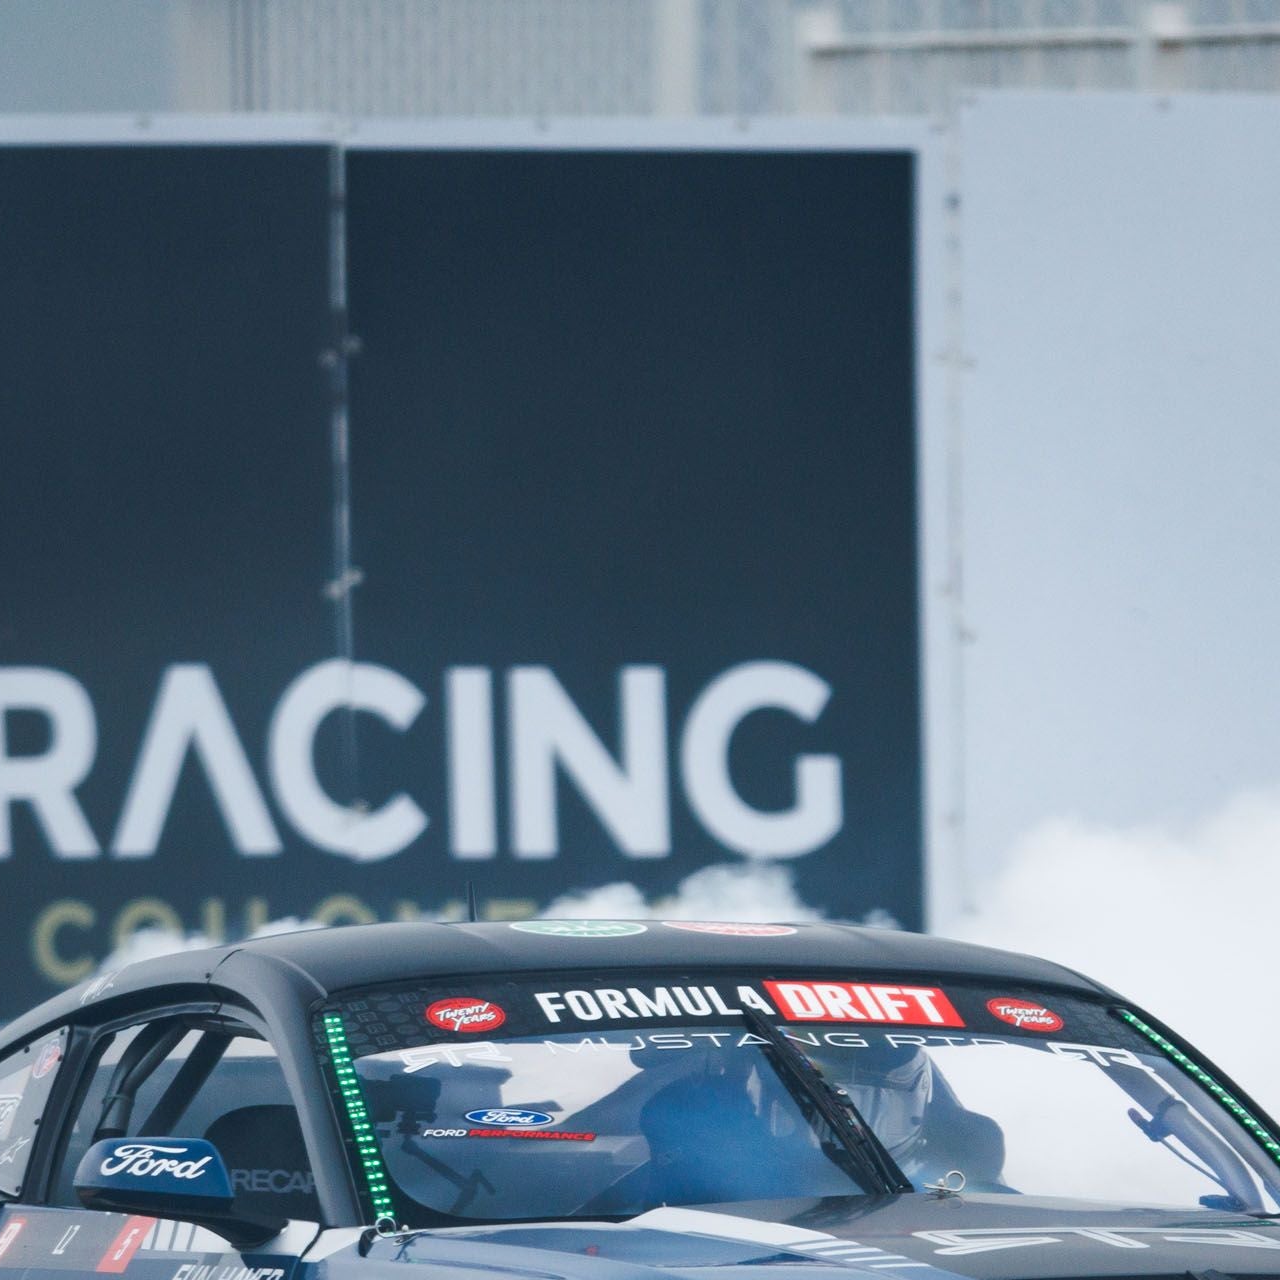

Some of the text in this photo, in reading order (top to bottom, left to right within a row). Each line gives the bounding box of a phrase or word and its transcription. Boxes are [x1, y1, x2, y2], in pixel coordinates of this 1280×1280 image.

[534, 984, 946, 1024] FORMULA DRIFT
[481, 1111, 535, 1124] Ford
[423, 1129, 595, 1141] FORD PERFORMANCE
[100, 1145, 213, 1179] Ford
